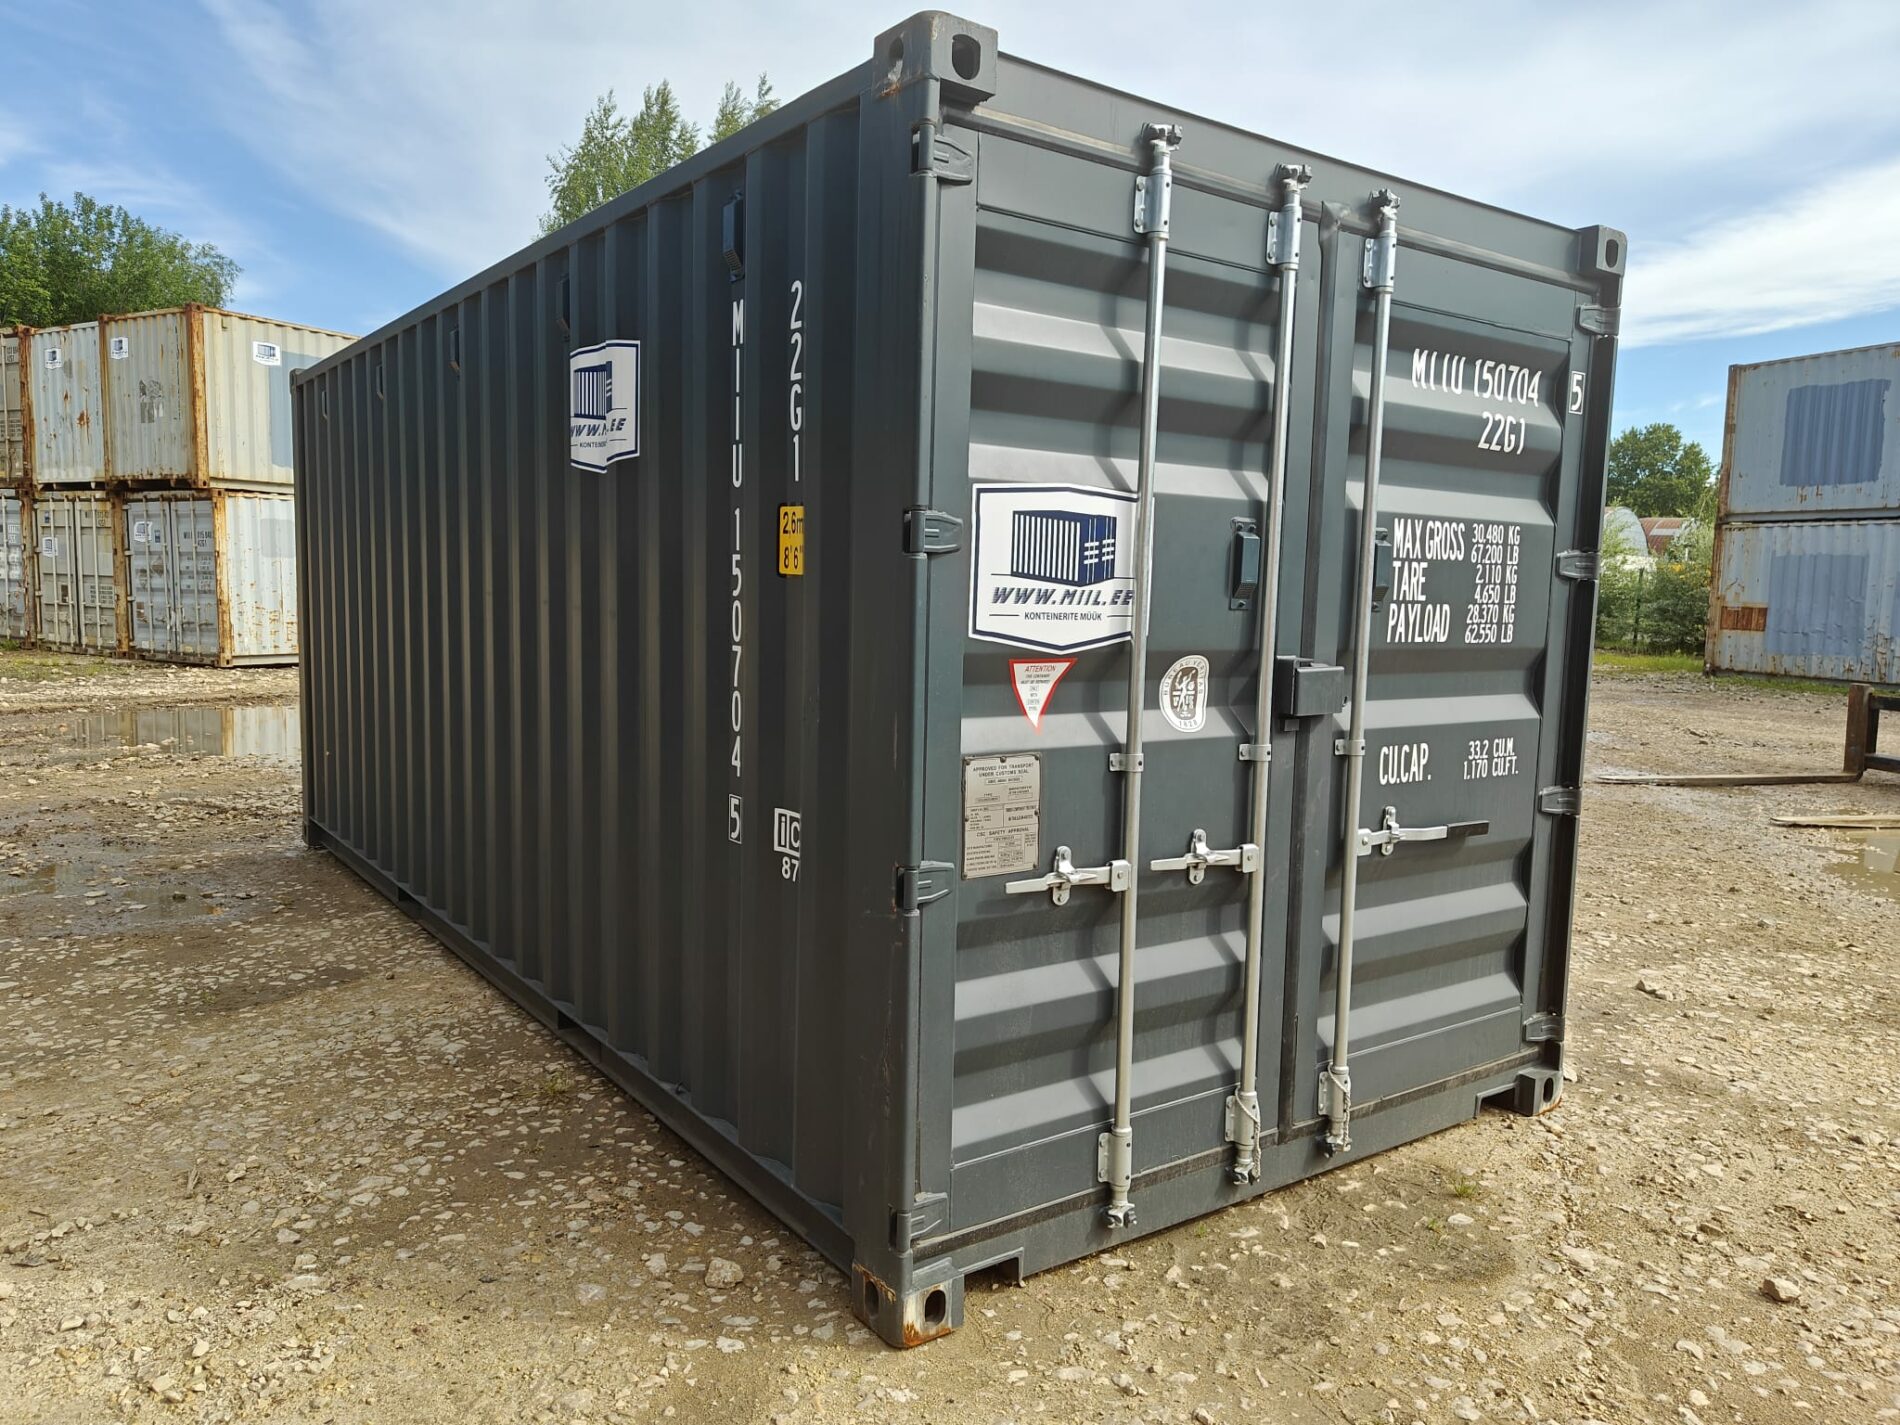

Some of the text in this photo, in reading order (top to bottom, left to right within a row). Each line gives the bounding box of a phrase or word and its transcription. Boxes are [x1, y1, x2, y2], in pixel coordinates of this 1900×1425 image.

[789, 280, 803, 482] 22G1
[1411, 348, 1583, 412] MIIU 150704 5
[1477, 412, 1525, 455] 22G1
[1393, 518, 1520, 561] MAX GROSS 30.480 KG
[1471, 545, 1519, 564] 67.200 LB
[729, 298, 744, 840] MIIU 150704 5
[1393, 561, 1518, 602] TARE 2.110 KG
[992, 587, 1135, 606] WWW.MIIL.EE
[1474, 584, 1516, 604] 4.650 LB
[1024, 611, 1102, 621] KONTEINERITE MÜÜK
[1387, 603, 1515, 643] PAYLOAD 28.370 KG
[1464, 624, 1513, 644] 62.550 LB
[1379, 738, 1515, 785] CU.CAP. 33.2 CU.M.
[1463, 756, 1519, 780] 1.170 CU.FT.
[781, 856, 800, 882] 87
